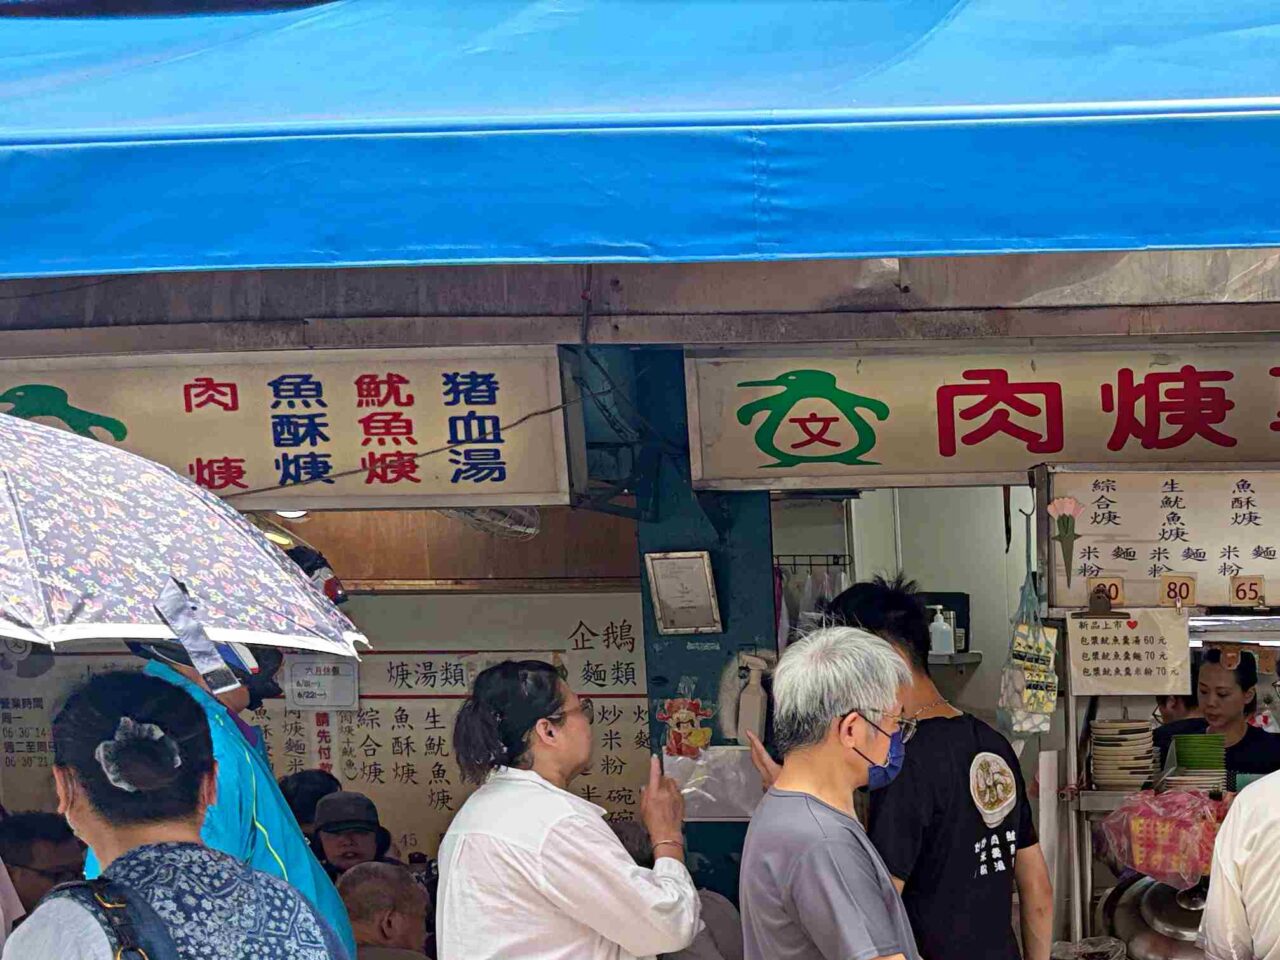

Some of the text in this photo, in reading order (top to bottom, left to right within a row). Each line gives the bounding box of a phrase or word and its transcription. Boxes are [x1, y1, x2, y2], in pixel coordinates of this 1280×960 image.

[789, 412, 841, 449] 文
[1167, 581, 1190, 600] 80
[1235, 582, 1259, 601] 65
[567, 619, 636, 653] 企鵝
[1079, 620, 1123, 630] 新品上市
[582, 660, 637, 687] 麵類
[597, 705, 627, 776] 炒米粉
